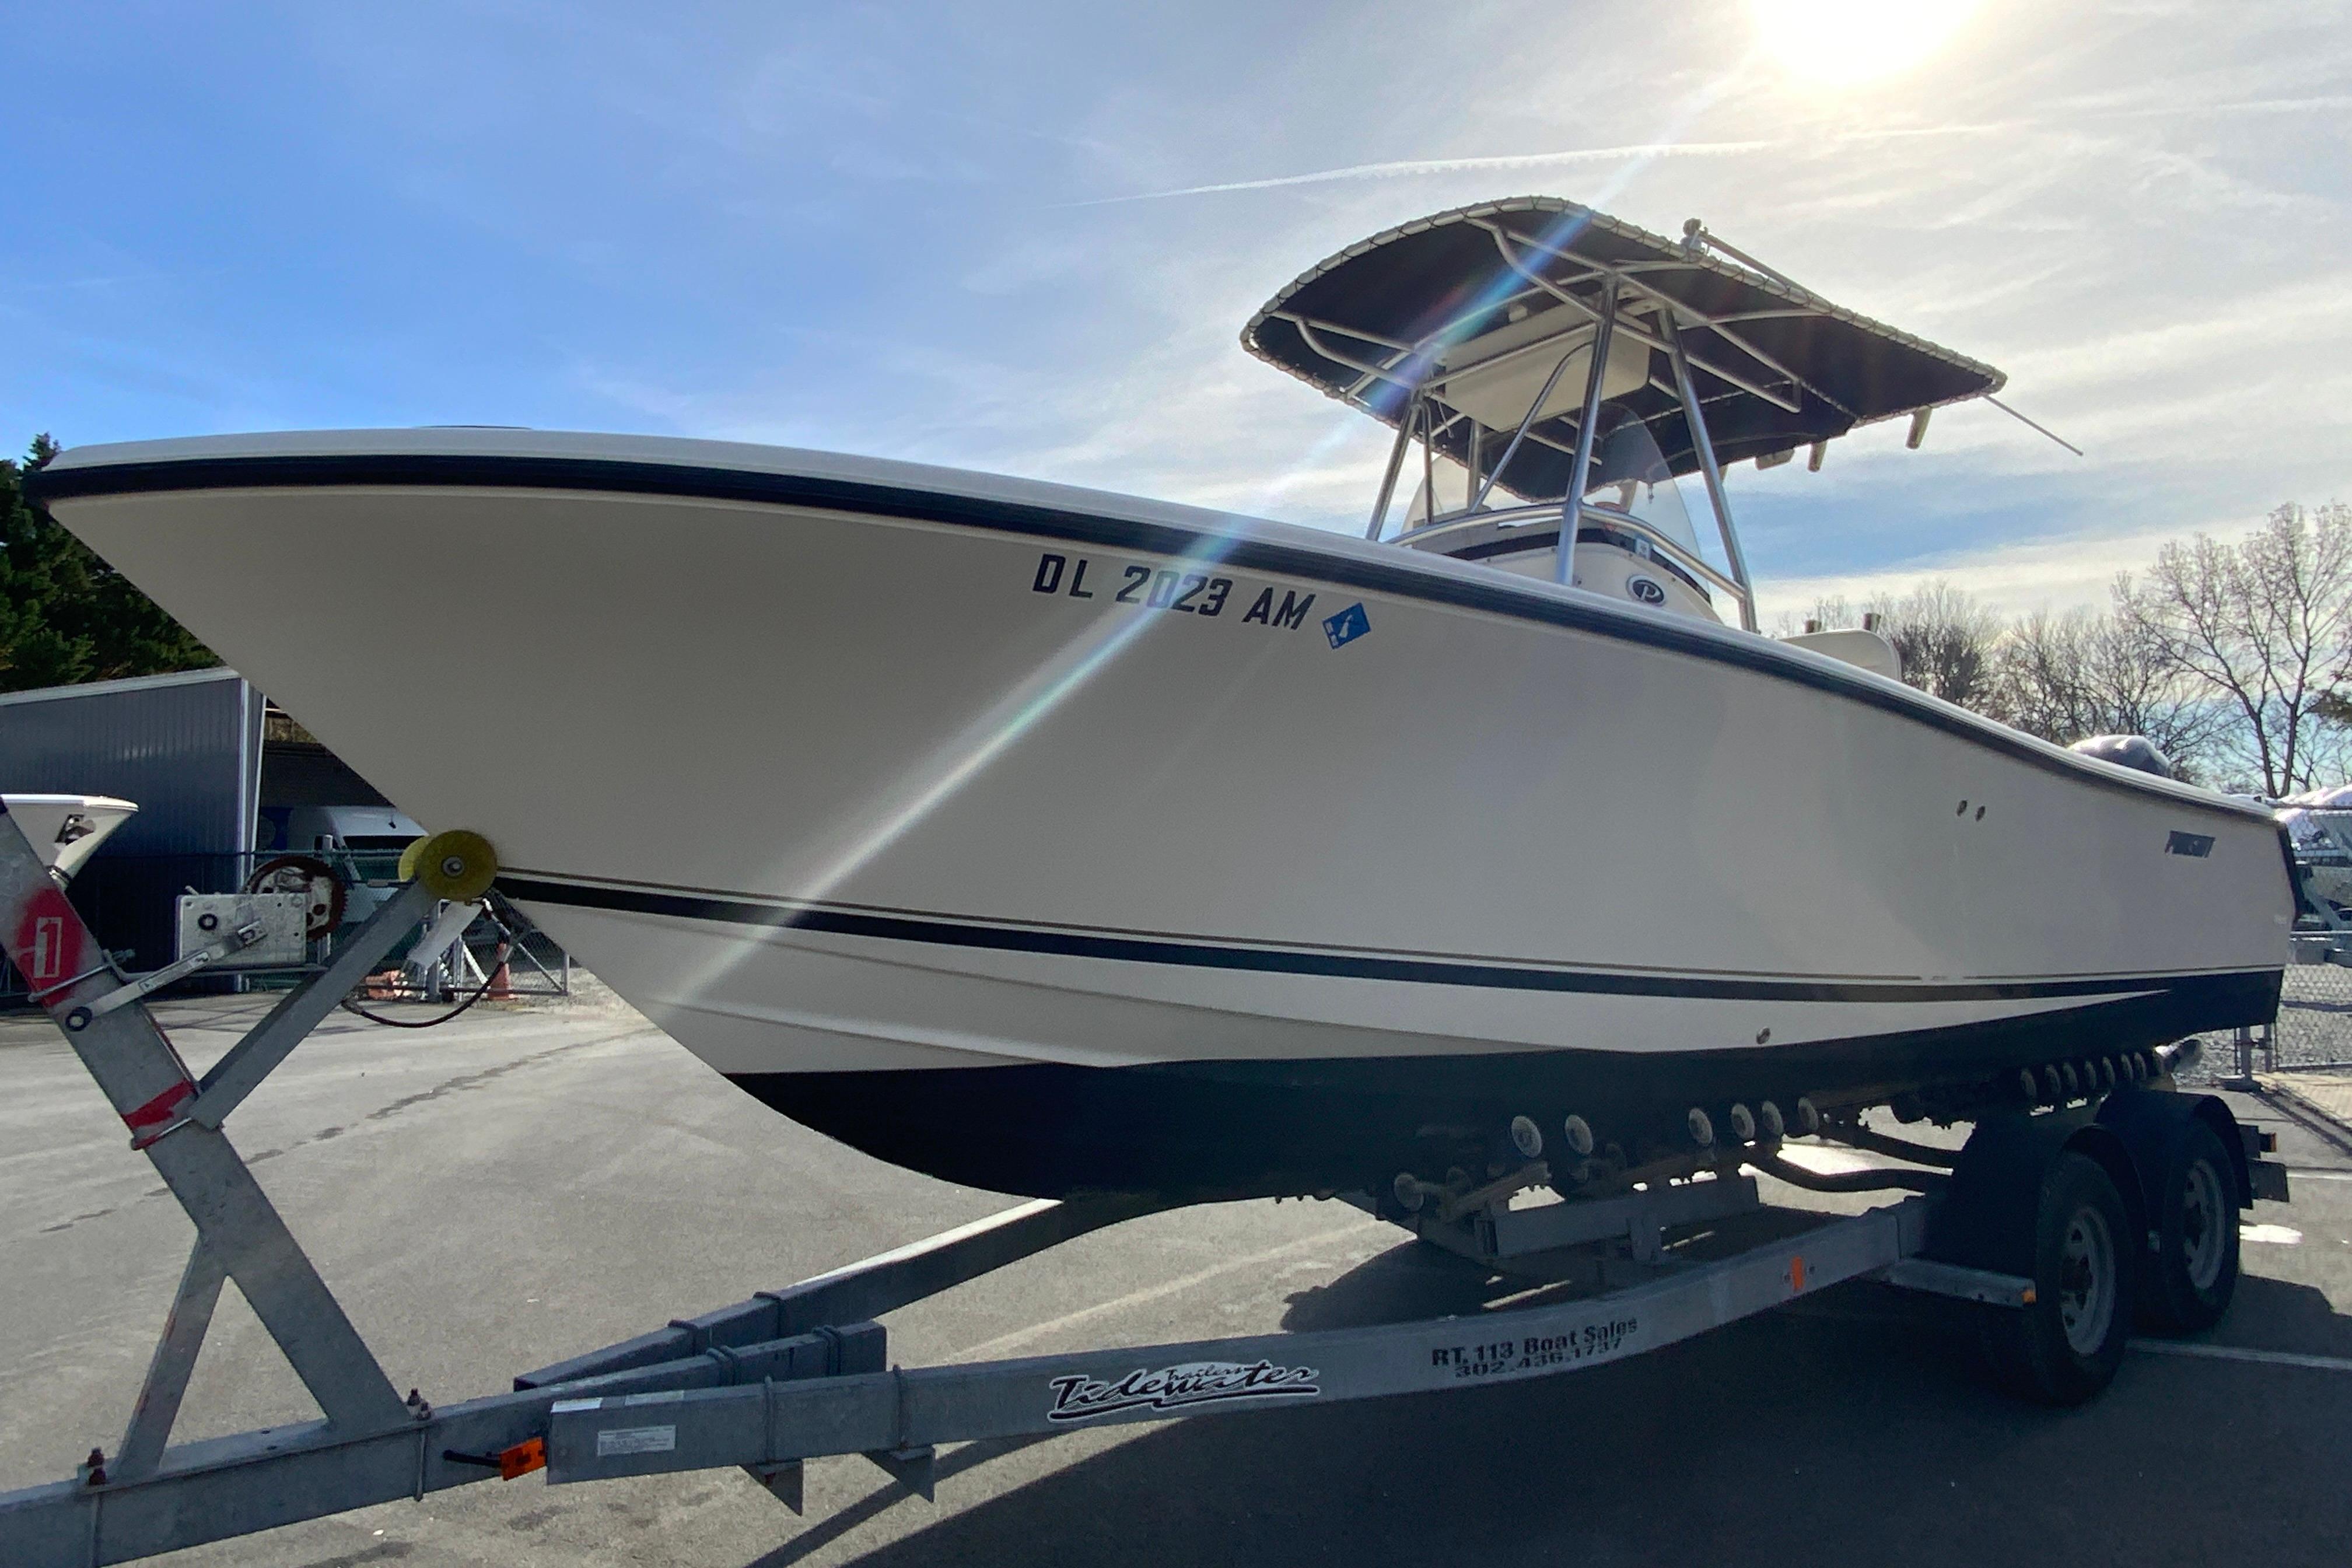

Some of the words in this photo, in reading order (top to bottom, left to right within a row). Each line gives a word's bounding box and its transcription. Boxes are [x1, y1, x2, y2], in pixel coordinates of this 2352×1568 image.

[1032, 554, 1093, 598] DL
[1115, 565, 1233, 617] 2023
[1241, 587, 1317, 631] AM
[1474, 1342, 1514, 1361] 113
[1523, 1330, 1577, 1356] Boat
[1584, 1318, 1637, 1343] Sales
